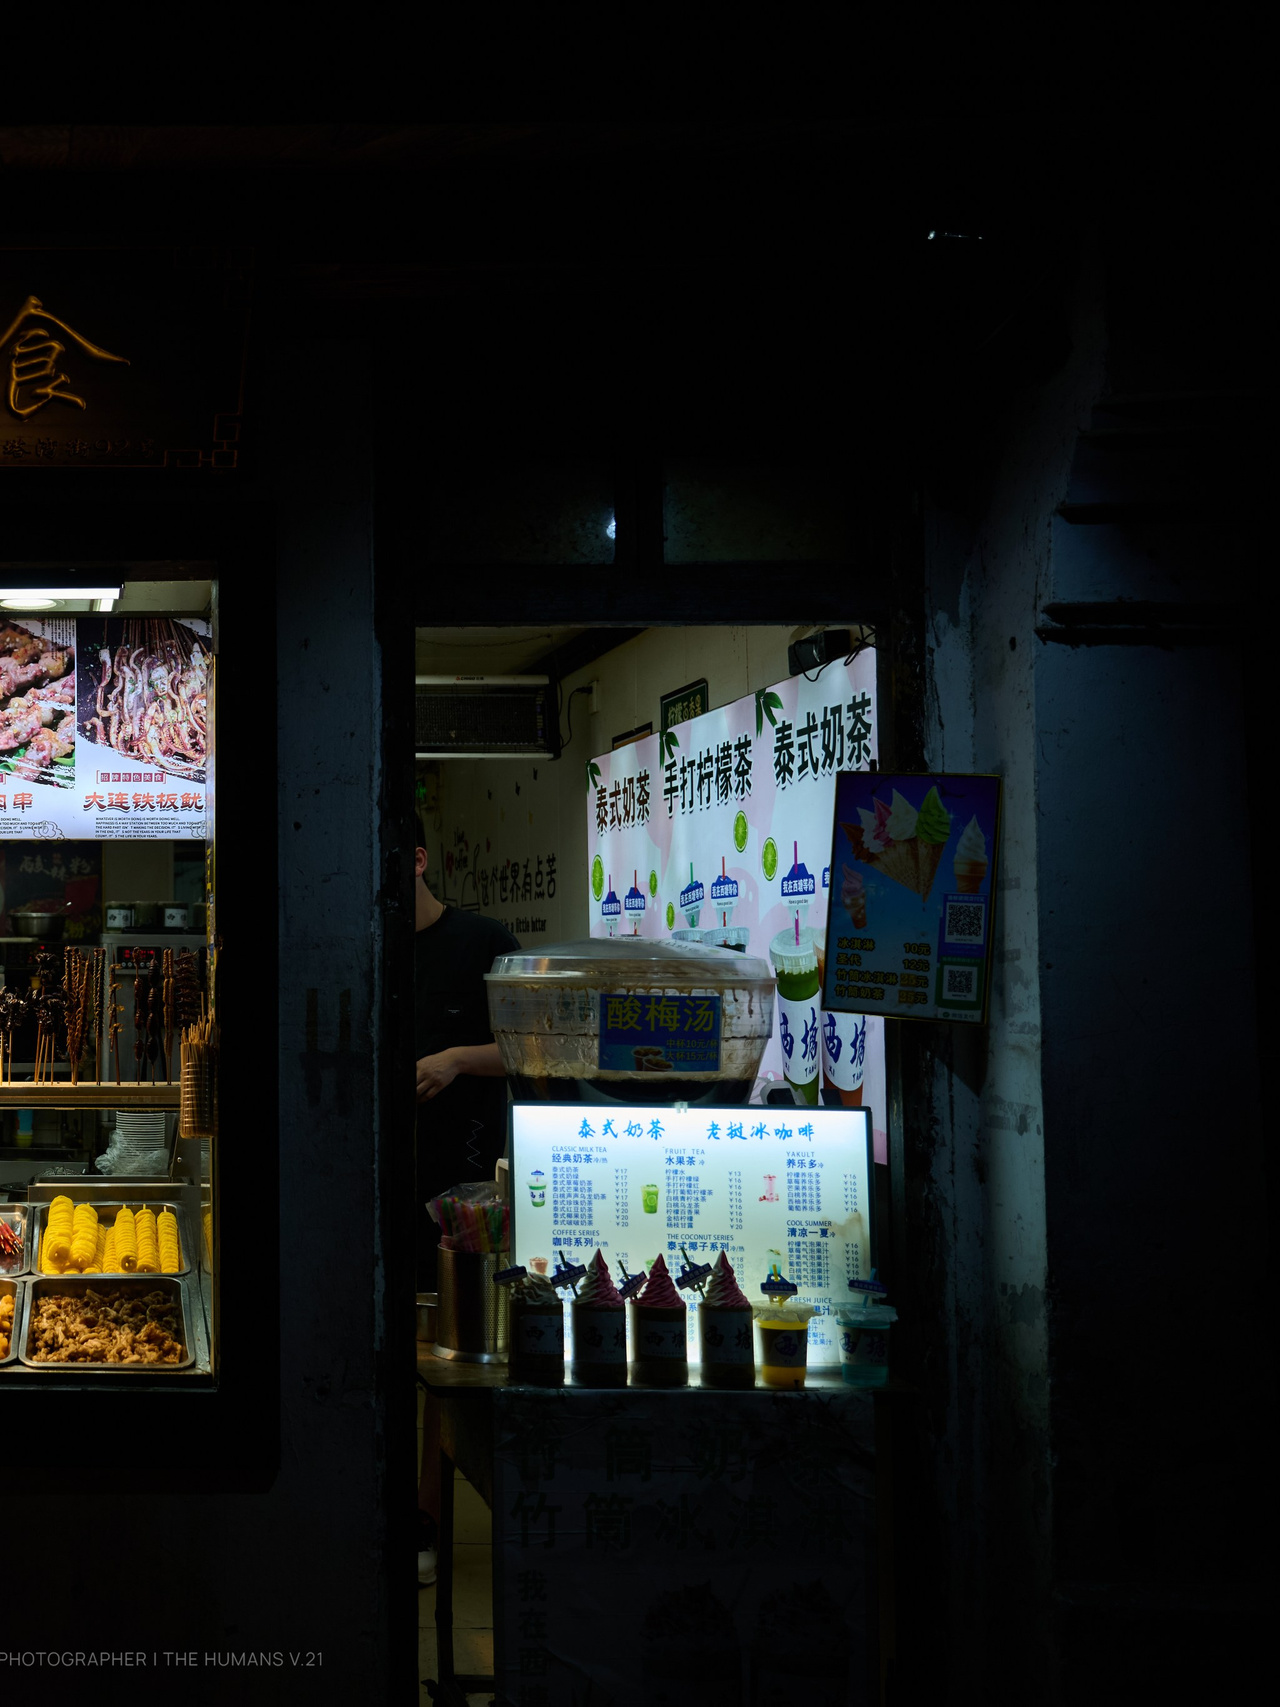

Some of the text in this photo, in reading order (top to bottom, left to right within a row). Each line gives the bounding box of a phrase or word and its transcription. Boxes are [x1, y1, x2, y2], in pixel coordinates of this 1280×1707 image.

[774, 692, 871, 784] 泰式奶茶
[663, 734, 753, 814] 手打柠檬茶
[595, 771, 650, 833] 泰式奶茶
[837, 936, 931, 956] 冰淇淋 10元
[836, 952, 862, 966] 圣代
[902, 959, 930, 971] 12元
[836, 968, 899, 985] 竹筒冰淇淋
[835, 984, 885, 1000] 竹筒奶茶
[606, 996, 714, 1032] 酸梅汤
[666, 1039, 718, 1048] 中杯10元/杯
[666, 1051, 718, 1061] 大杯15元/杯
[578, 1118, 666, 1140] 泰式奶茶
[552, 1153, 592, 1163] 经典奶茶
[665, 1156, 696, 1166] 水果茶
[787, 1159, 817, 1169] 养乐多
[787, 1227, 829, 1238] 清凉一夏
[552, 1237, 593, 1247] 咖啡系列
[667, 1241, 729, 1252] 泰式椰子系列
